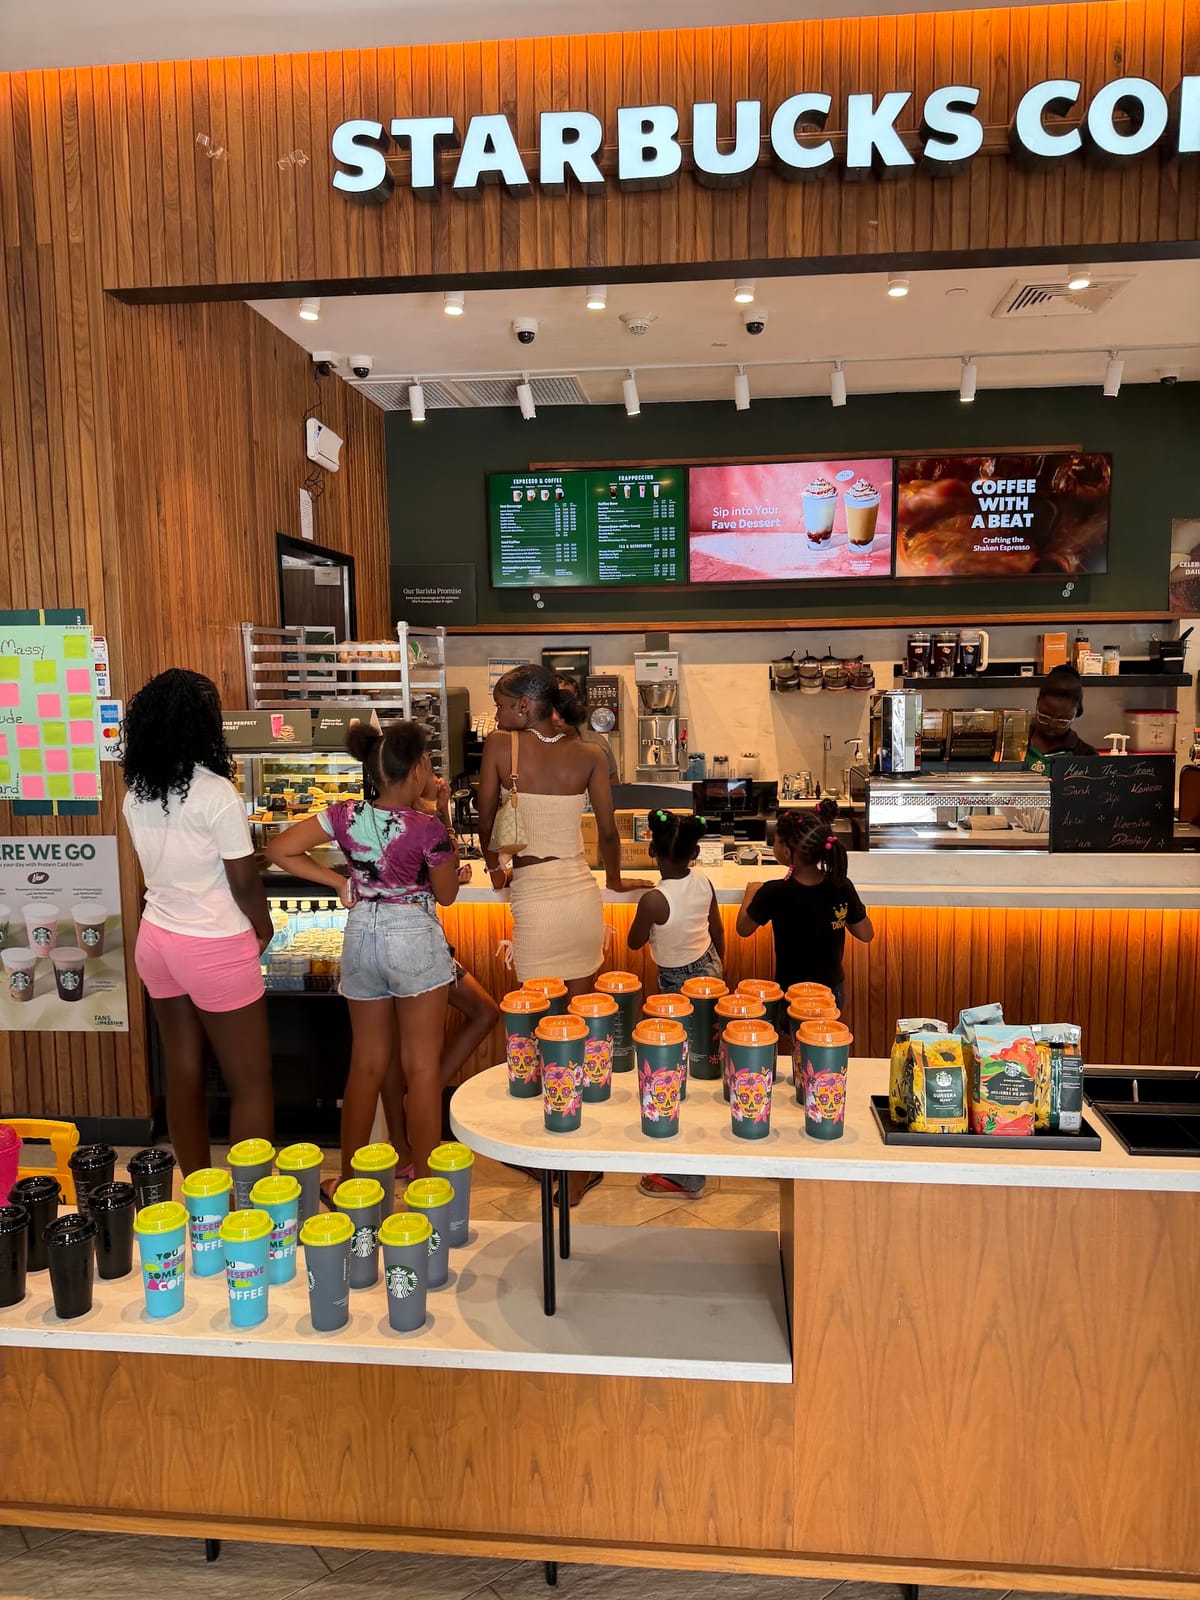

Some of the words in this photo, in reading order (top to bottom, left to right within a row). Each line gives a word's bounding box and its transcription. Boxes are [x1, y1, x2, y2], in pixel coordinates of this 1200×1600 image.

[331, 85, 984, 193] STARBUCKS
[971, 479, 1036, 495] COFFEE
[978, 496, 1029, 512] WITH
[712, 507, 729, 517] Sip
[731, 507, 753, 516] into
[755, 505, 779, 515] Your
[711, 520, 737, 530] Fave
[739, 518, 781, 529] Dessert
[971, 514, 985, 529] A
[988, 513, 1034, 528] BEAT
[983, 536, 1010, 544] Crafting
[973, 544, 998, 552] Shaken
[999, 543, 1030, 552] Espresso
[28, 843, 61, 860] WE
[65, 843, 95, 860] GO
[156, 1249, 178, 1261] YOU
[148, 1268, 177, 1280] SOME
